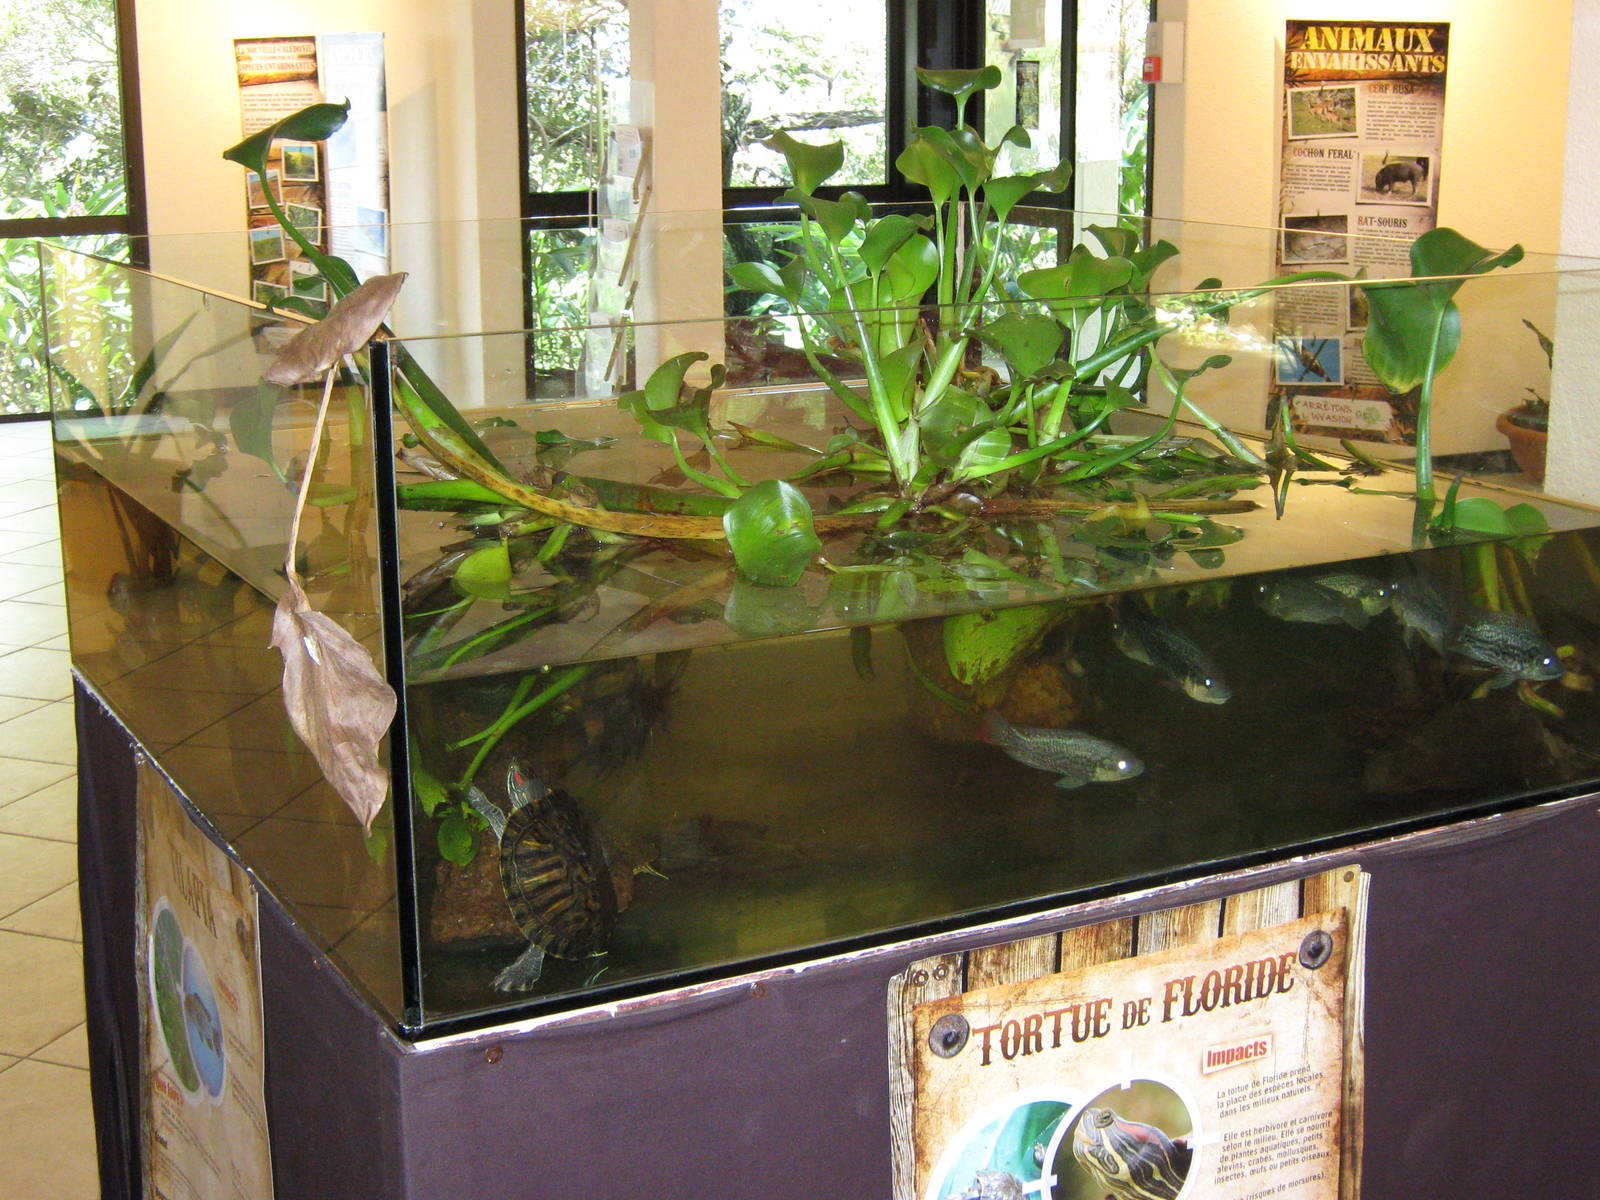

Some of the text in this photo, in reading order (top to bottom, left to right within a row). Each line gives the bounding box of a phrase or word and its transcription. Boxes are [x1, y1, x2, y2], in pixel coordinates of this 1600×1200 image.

[1300, 26, 1435, 53] ANIMAUX
[1290, 51, 1446, 73] ENVAHISSANTS
[1368, 83, 1415, 95] CERF RUSA
[1293, 147, 1324, 158] COCHON
[1358, 216, 1408, 228] RAT-SOURIS
[971, 951, 1298, 1067] TORTUE DE FLORIDE
[1206, 1040, 1267, 1068] Impacts
[1217, 1065, 1311, 1100] La tortue de Floride prend
[1217, 1100, 1224, 1109] la
[1226, 1094, 1247, 1108] place
[1249, 1090, 1262, 1099] des
[1264, 1080, 1294, 1096] espèces
[1219, 1108, 1237, 1119] dans
[1239, 1102, 1251, 1112] les
[1252, 1095, 1279, 1108] milieux
[1222, 1120, 1331, 1153] selon le milieu. Elle se nourrit
[1223, 1110, 1333, 1142] Elle est herbivore et carnivore
[1219, 1154, 1229, 1164] de
[1231, 1148, 1258, 1162] plantes
[1302, 1132, 1323, 1147] petits
[1216, 1162, 1246, 1175] alevins,
[1249, 1164, 1267, 1176] œufs
[1268, 1163, 1278, 1172] ou
[1279, 1157, 1299, 1170] petits
[1246, 1186, 1276, 1200] (risques
[1277, 1182, 1286, 1192] de
